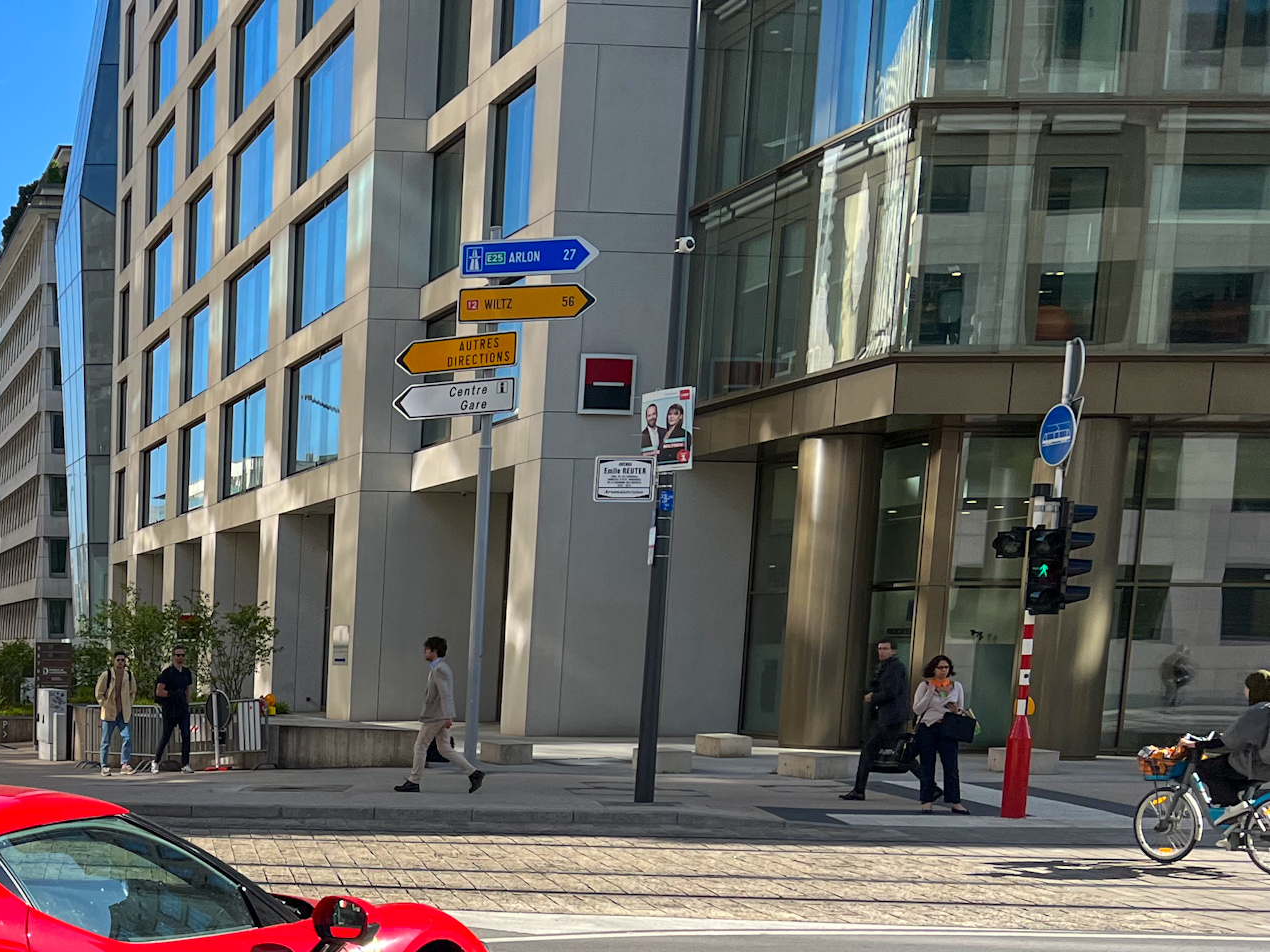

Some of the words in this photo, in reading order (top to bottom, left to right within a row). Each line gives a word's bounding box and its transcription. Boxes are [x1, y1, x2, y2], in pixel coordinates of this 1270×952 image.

[487, 254, 504, 262] E25
[508, 250, 541, 263] ARLON
[562, 248, 577, 260] 27
[484, 298, 513, 310] WILTZ
[562, 296, 575, 307] 56
[459, 337, 500, 352] AUTRES
[447, 351, 510, 368] DIRECTIONS
[449, 385, 488, 398] Centre
[460, 400, 488, 411] Gare
